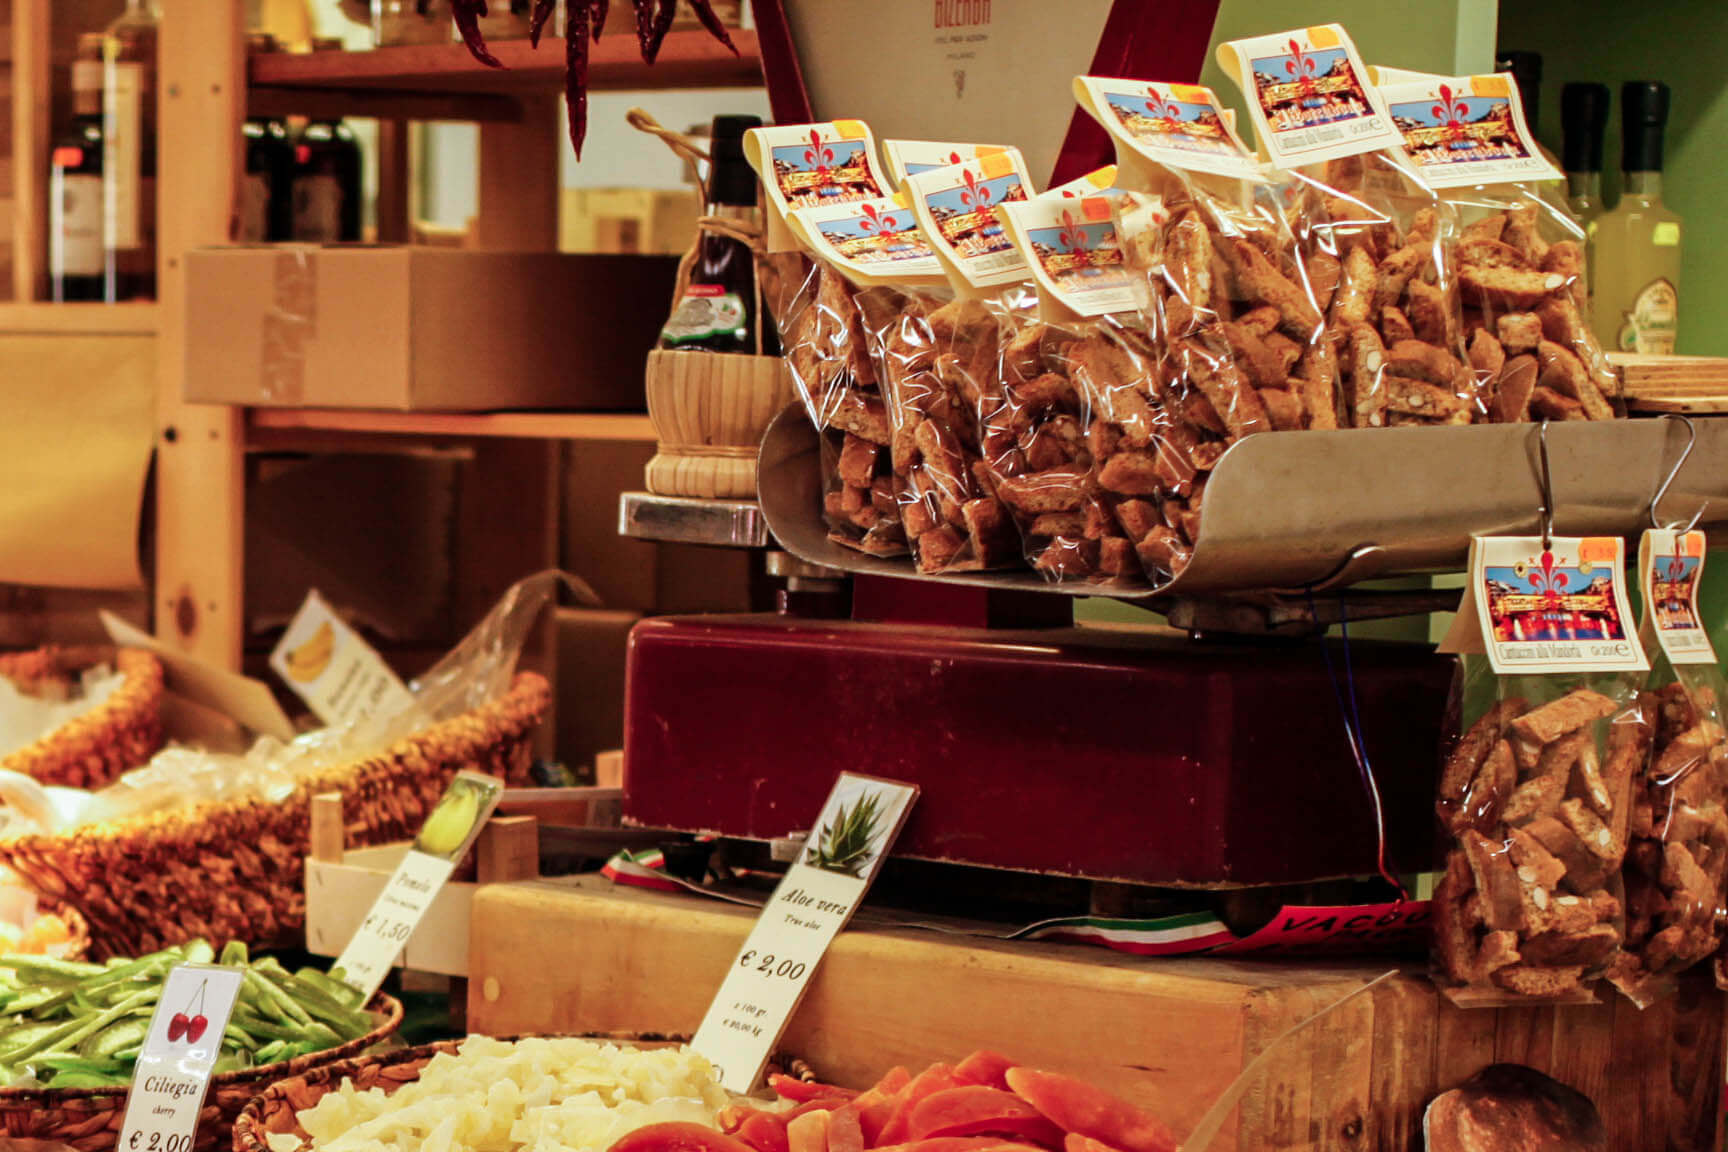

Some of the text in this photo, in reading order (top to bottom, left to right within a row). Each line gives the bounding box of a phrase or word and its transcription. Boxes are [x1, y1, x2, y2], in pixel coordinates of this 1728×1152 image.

[781, 889, 848, 916] Aloe vera
[364, 915, 410, 941] € 1,50
[784, 914, 802, 927] True
[740, 950, 806, 980] € 2,00
[145, 1076, 198, 1099] Ciliegia
[152, 1105, 176, 1119] cherry
[129, 1130, 143, 1150] €
